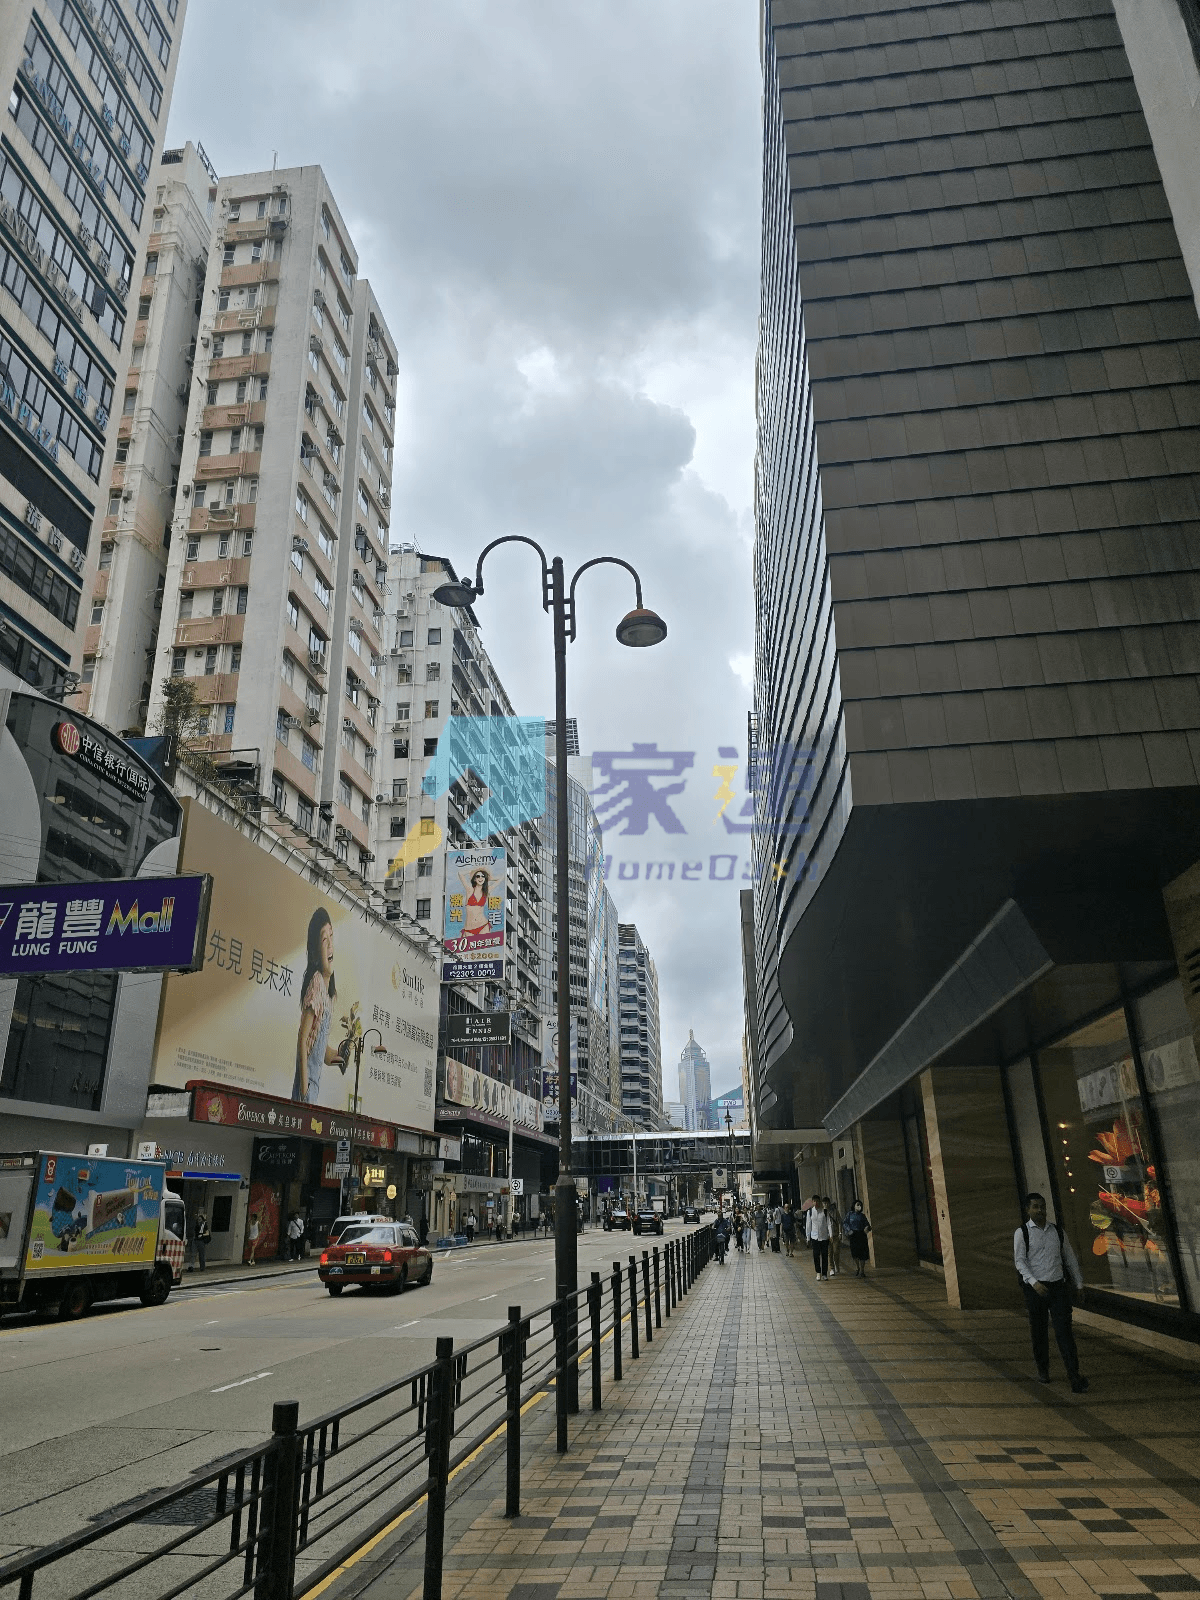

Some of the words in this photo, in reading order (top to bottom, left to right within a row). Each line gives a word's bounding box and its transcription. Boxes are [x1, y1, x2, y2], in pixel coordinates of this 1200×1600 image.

[23, 57, 72, 140] CANTON
[72, 132, 107, 200] PLAZA
[47, 256, 84, 325] PLAZA
[78, 220, 131, 303] 流尚坊
[53, 354, 110, 432] 流尚坊
[18, 400, 59, 464] PLAZA
[26, 501, 86, 573] 流尚坊
[455, 854, 498, 865] Alchemy
[12, 943, 51, 957] LUNG
[58, 940, 98, 955] FUNG
[15, 899, 104, 941] 龍豐
[105, 896, 176, 937] Mall
[207, 928, 243, 975] 先見
[248, 948, 294, 997] 見未來
[402, 967, 414, 989] Sun
[413, 973, 425, 996] Life
